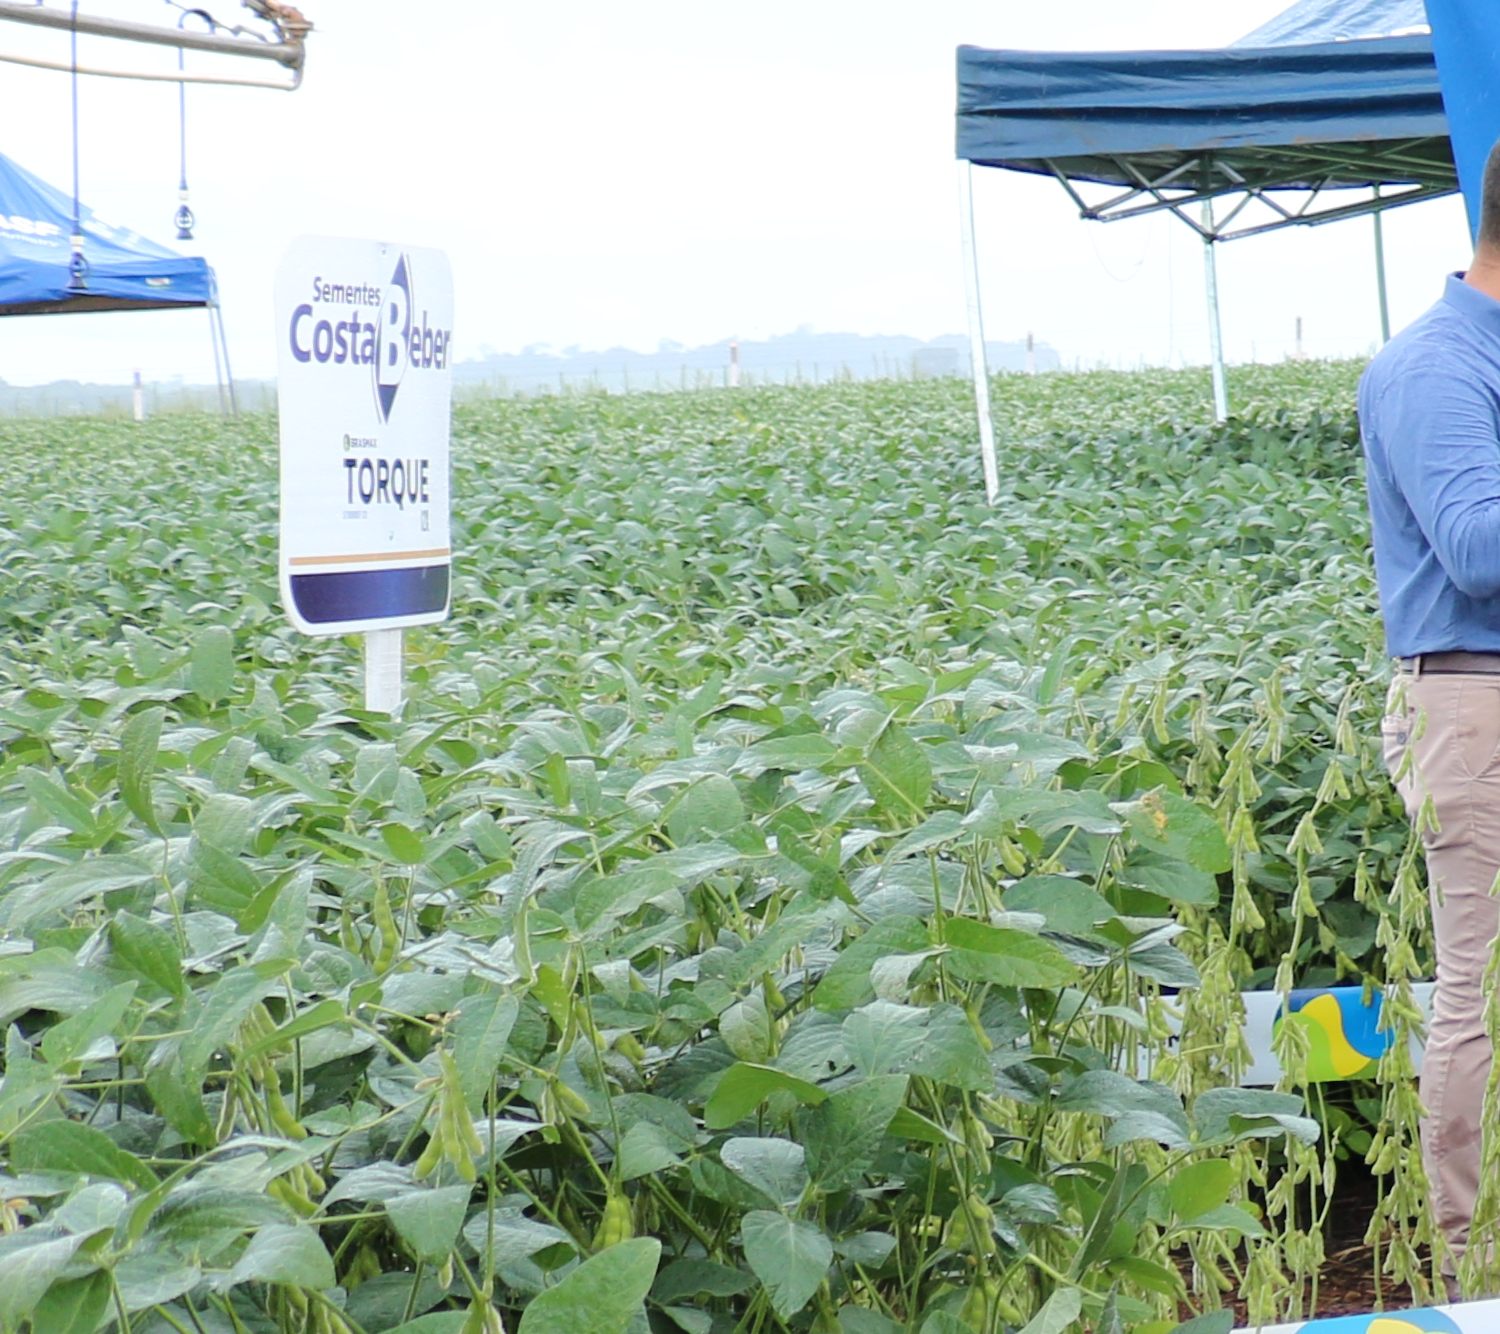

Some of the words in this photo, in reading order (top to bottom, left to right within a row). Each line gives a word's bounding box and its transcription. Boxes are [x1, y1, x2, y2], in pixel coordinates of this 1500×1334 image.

[312, 276, 382, 307] Sementes
[289, 303, 376, 366] Costa
[377, 284, 451, 385] Beber
[343, 457, 430, 511] TORQUE
